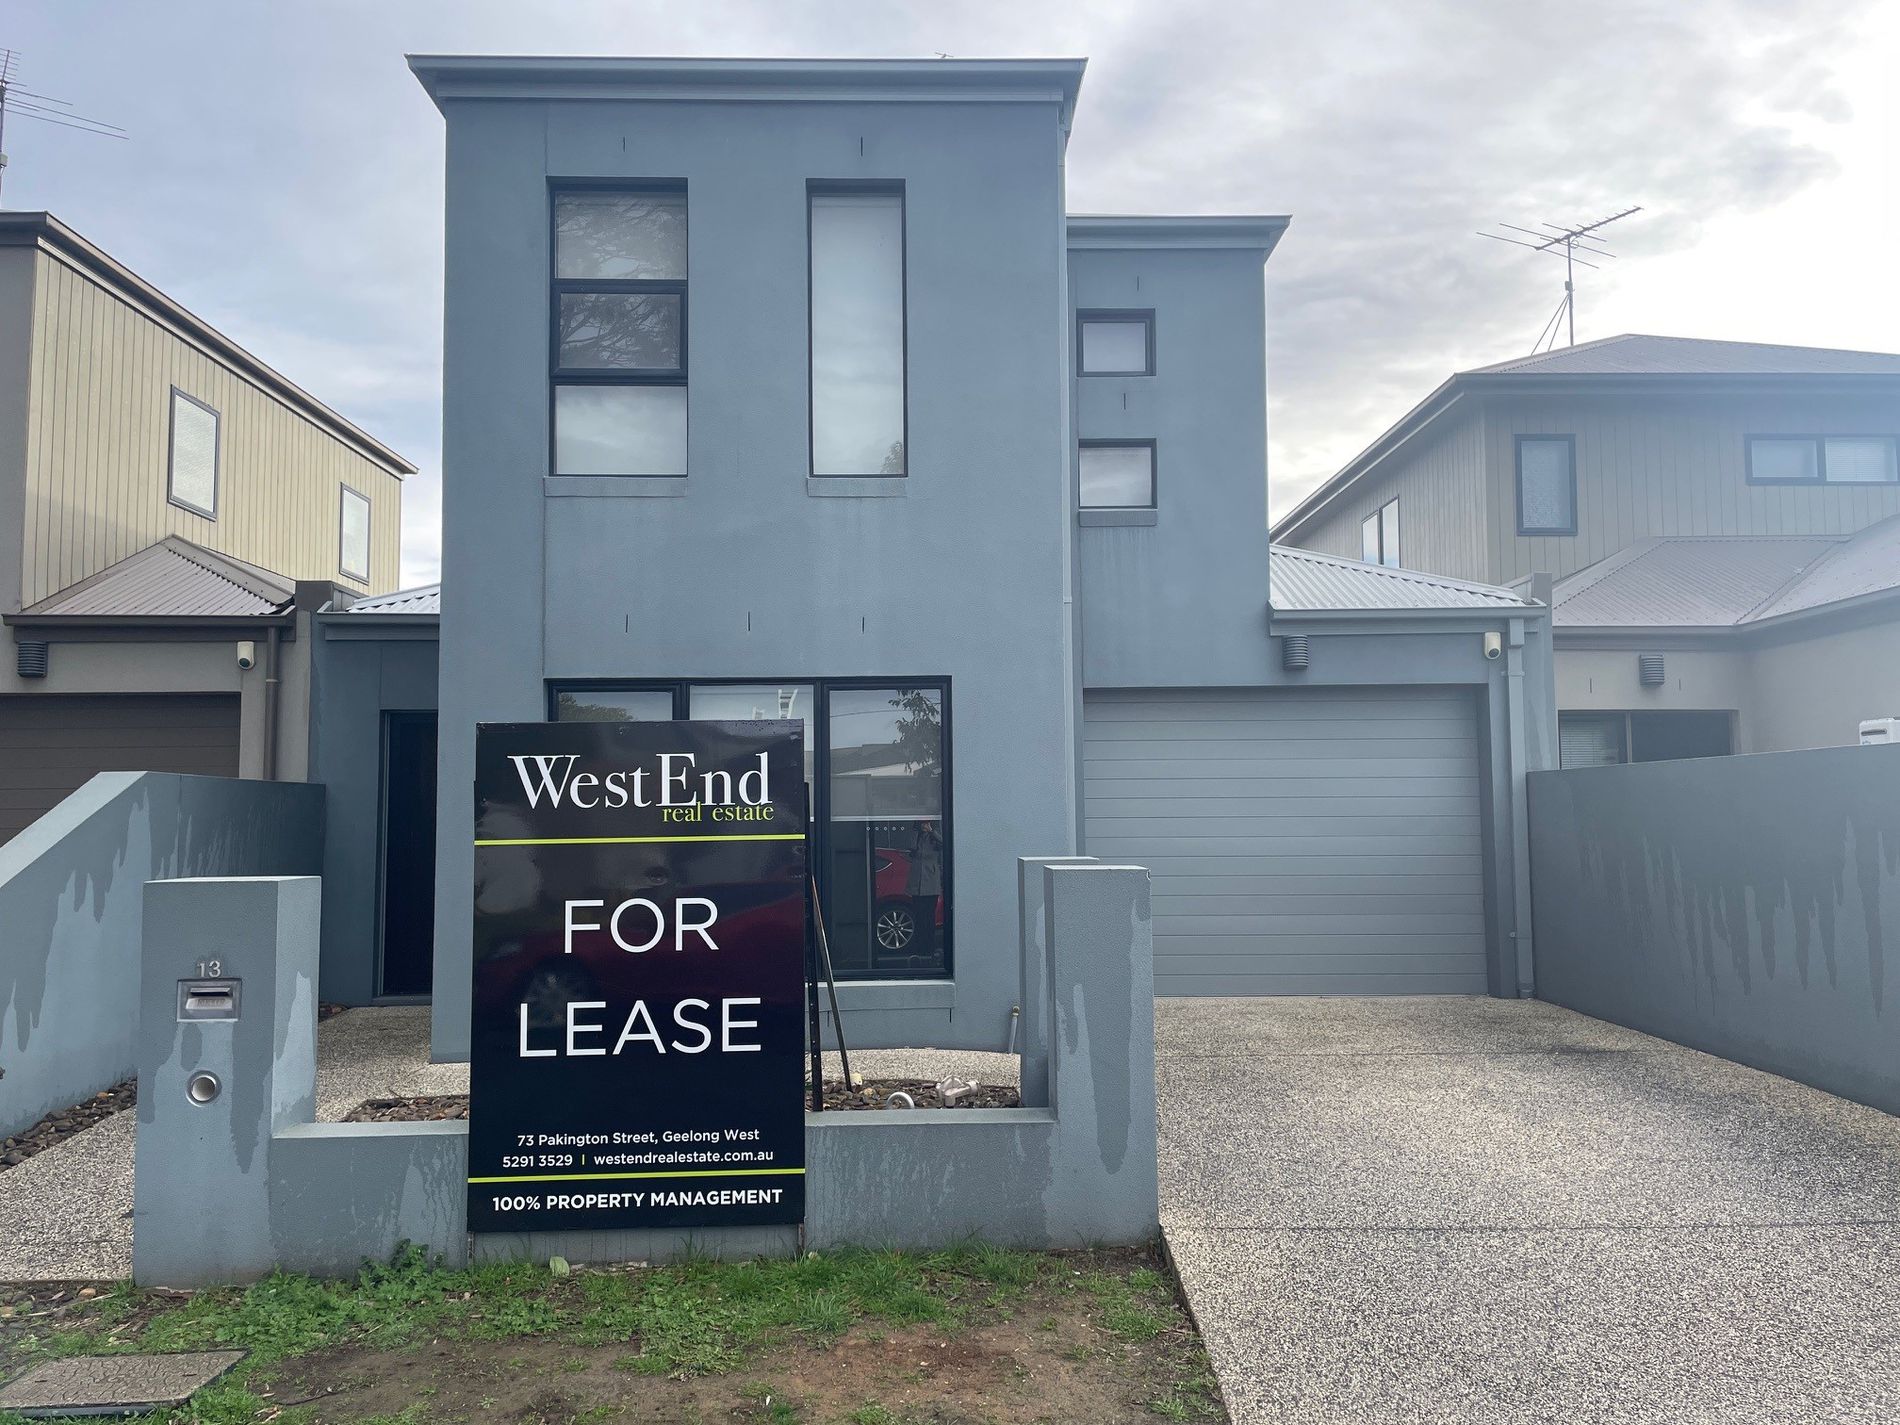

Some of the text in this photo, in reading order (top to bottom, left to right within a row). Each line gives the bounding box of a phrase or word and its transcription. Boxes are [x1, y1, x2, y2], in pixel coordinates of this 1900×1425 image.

[662, 801, 774, 822] real estate
[564, 897, 720, 954] FOR
[197, 960, 222, 978] 13
[519, 997, 762, 1058] LEASE
[517, 1128, 760, 1148] 73 Pakington Street, Geelong West
[502, 1150, 774, 1168] 5291 3529 westendrealestate.com.au
[492, 1188, 783, 1211] 100% PROPERTY MANAGEMENT
